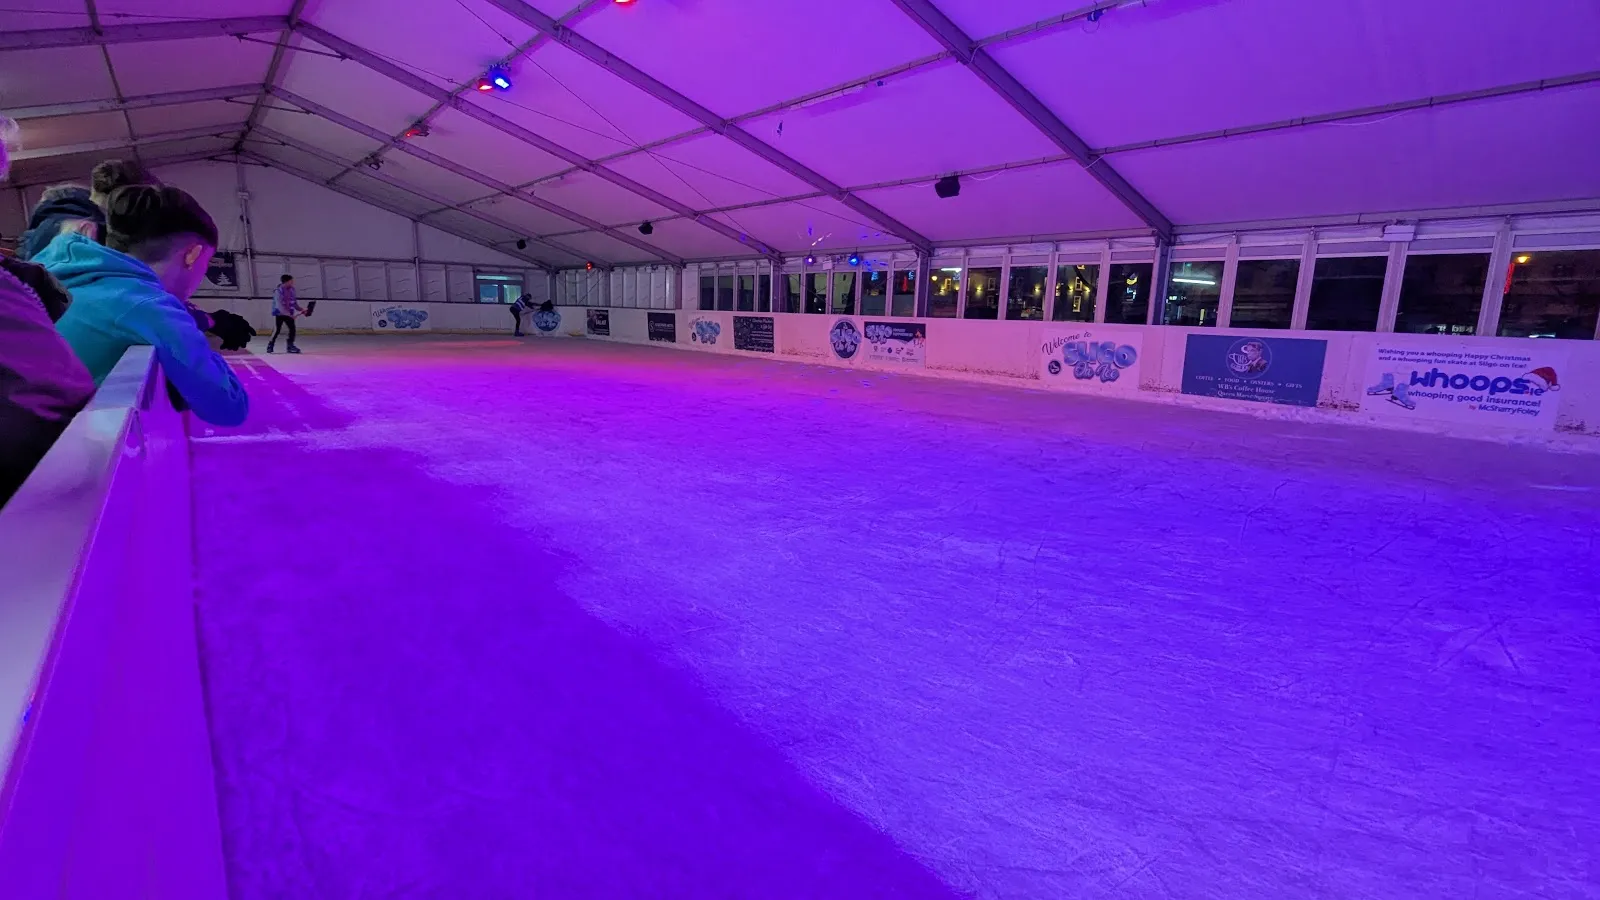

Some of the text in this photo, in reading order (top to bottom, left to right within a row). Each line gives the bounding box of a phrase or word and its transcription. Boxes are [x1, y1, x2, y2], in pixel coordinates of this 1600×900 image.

[1041, 333, 1080, 356] Welcome
[1063, 341, 1137, 369] SLIGO
[1074, 362, 1120, 383] On Ice
[1233, 385, 1255, 393] Coffee
[1407, 390, 1541, 407] whooping good insurance!
[1478, 404, 1540, 417] McSharryFoley
